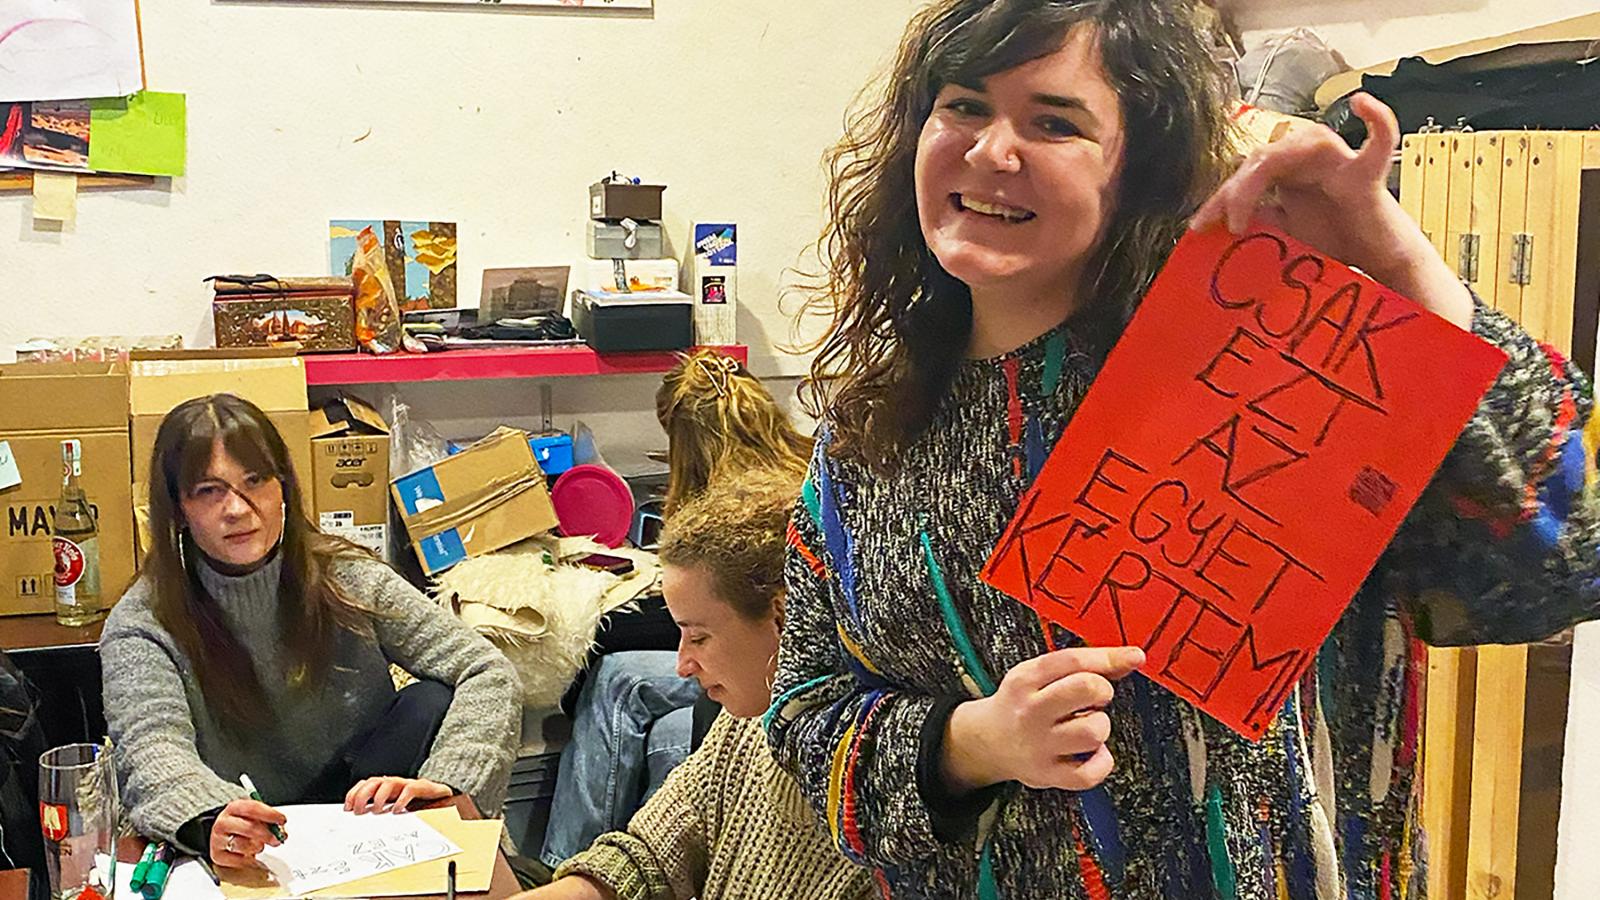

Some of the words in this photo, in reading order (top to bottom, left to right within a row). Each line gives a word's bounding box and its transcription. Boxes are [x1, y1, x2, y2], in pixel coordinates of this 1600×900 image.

[1210, 232, 1420, 399] CSAK
[1195, 326, 1388, 446] EZT
[336, 458, 367, 467] acer
[1172, 413, 1310, 527] AZ
[1073, 449, 1326, 614] EGYET
